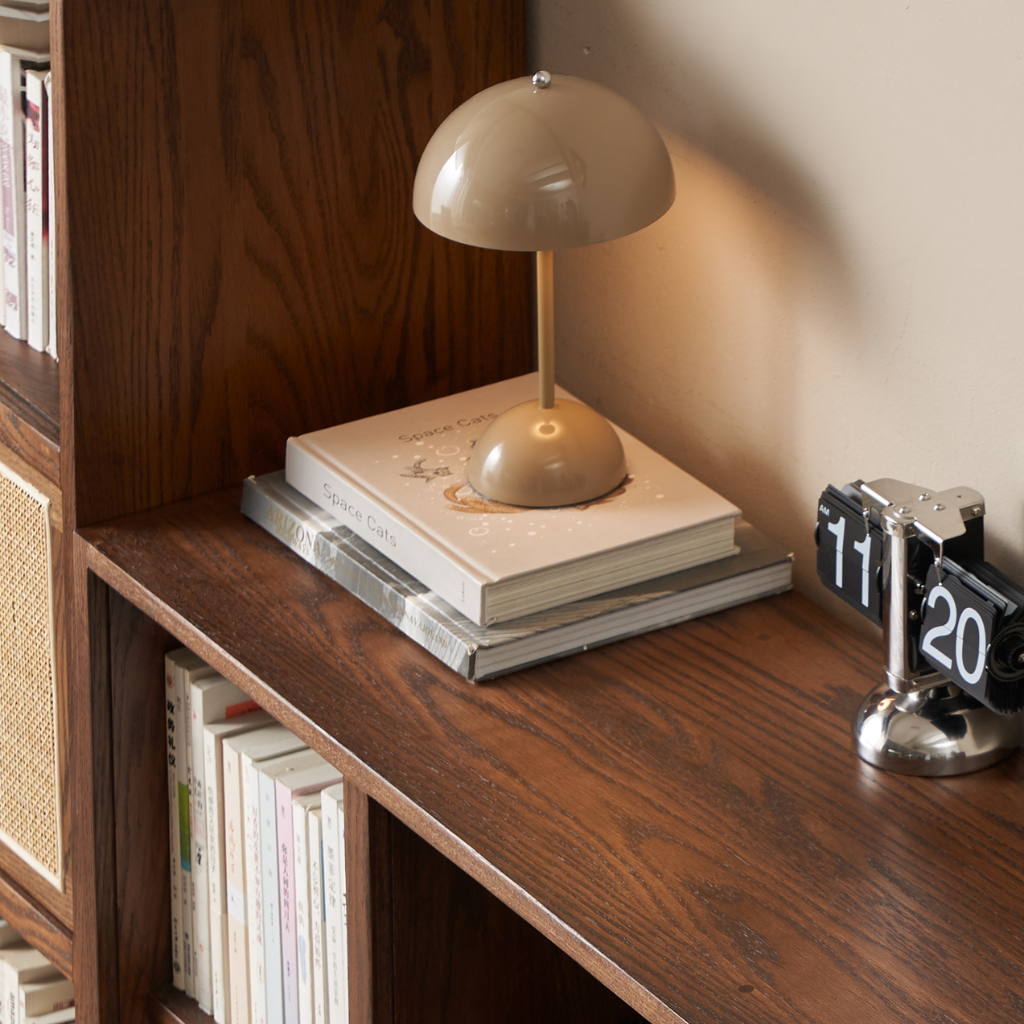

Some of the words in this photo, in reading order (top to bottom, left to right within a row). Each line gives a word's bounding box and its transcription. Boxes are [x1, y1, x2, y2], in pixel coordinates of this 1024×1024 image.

[398, 424, 454, 443] Space
[456, 412, 499, 428] Cats
[267, 504, 320, 557] ARIZONA
[323, 483, 363, 522] Space
[367, 515, 397, 547] Cats
[818, 504, 831, 517] AM
[827, 515, 872, 608] 11
[921, 585, 986, 686] 20
